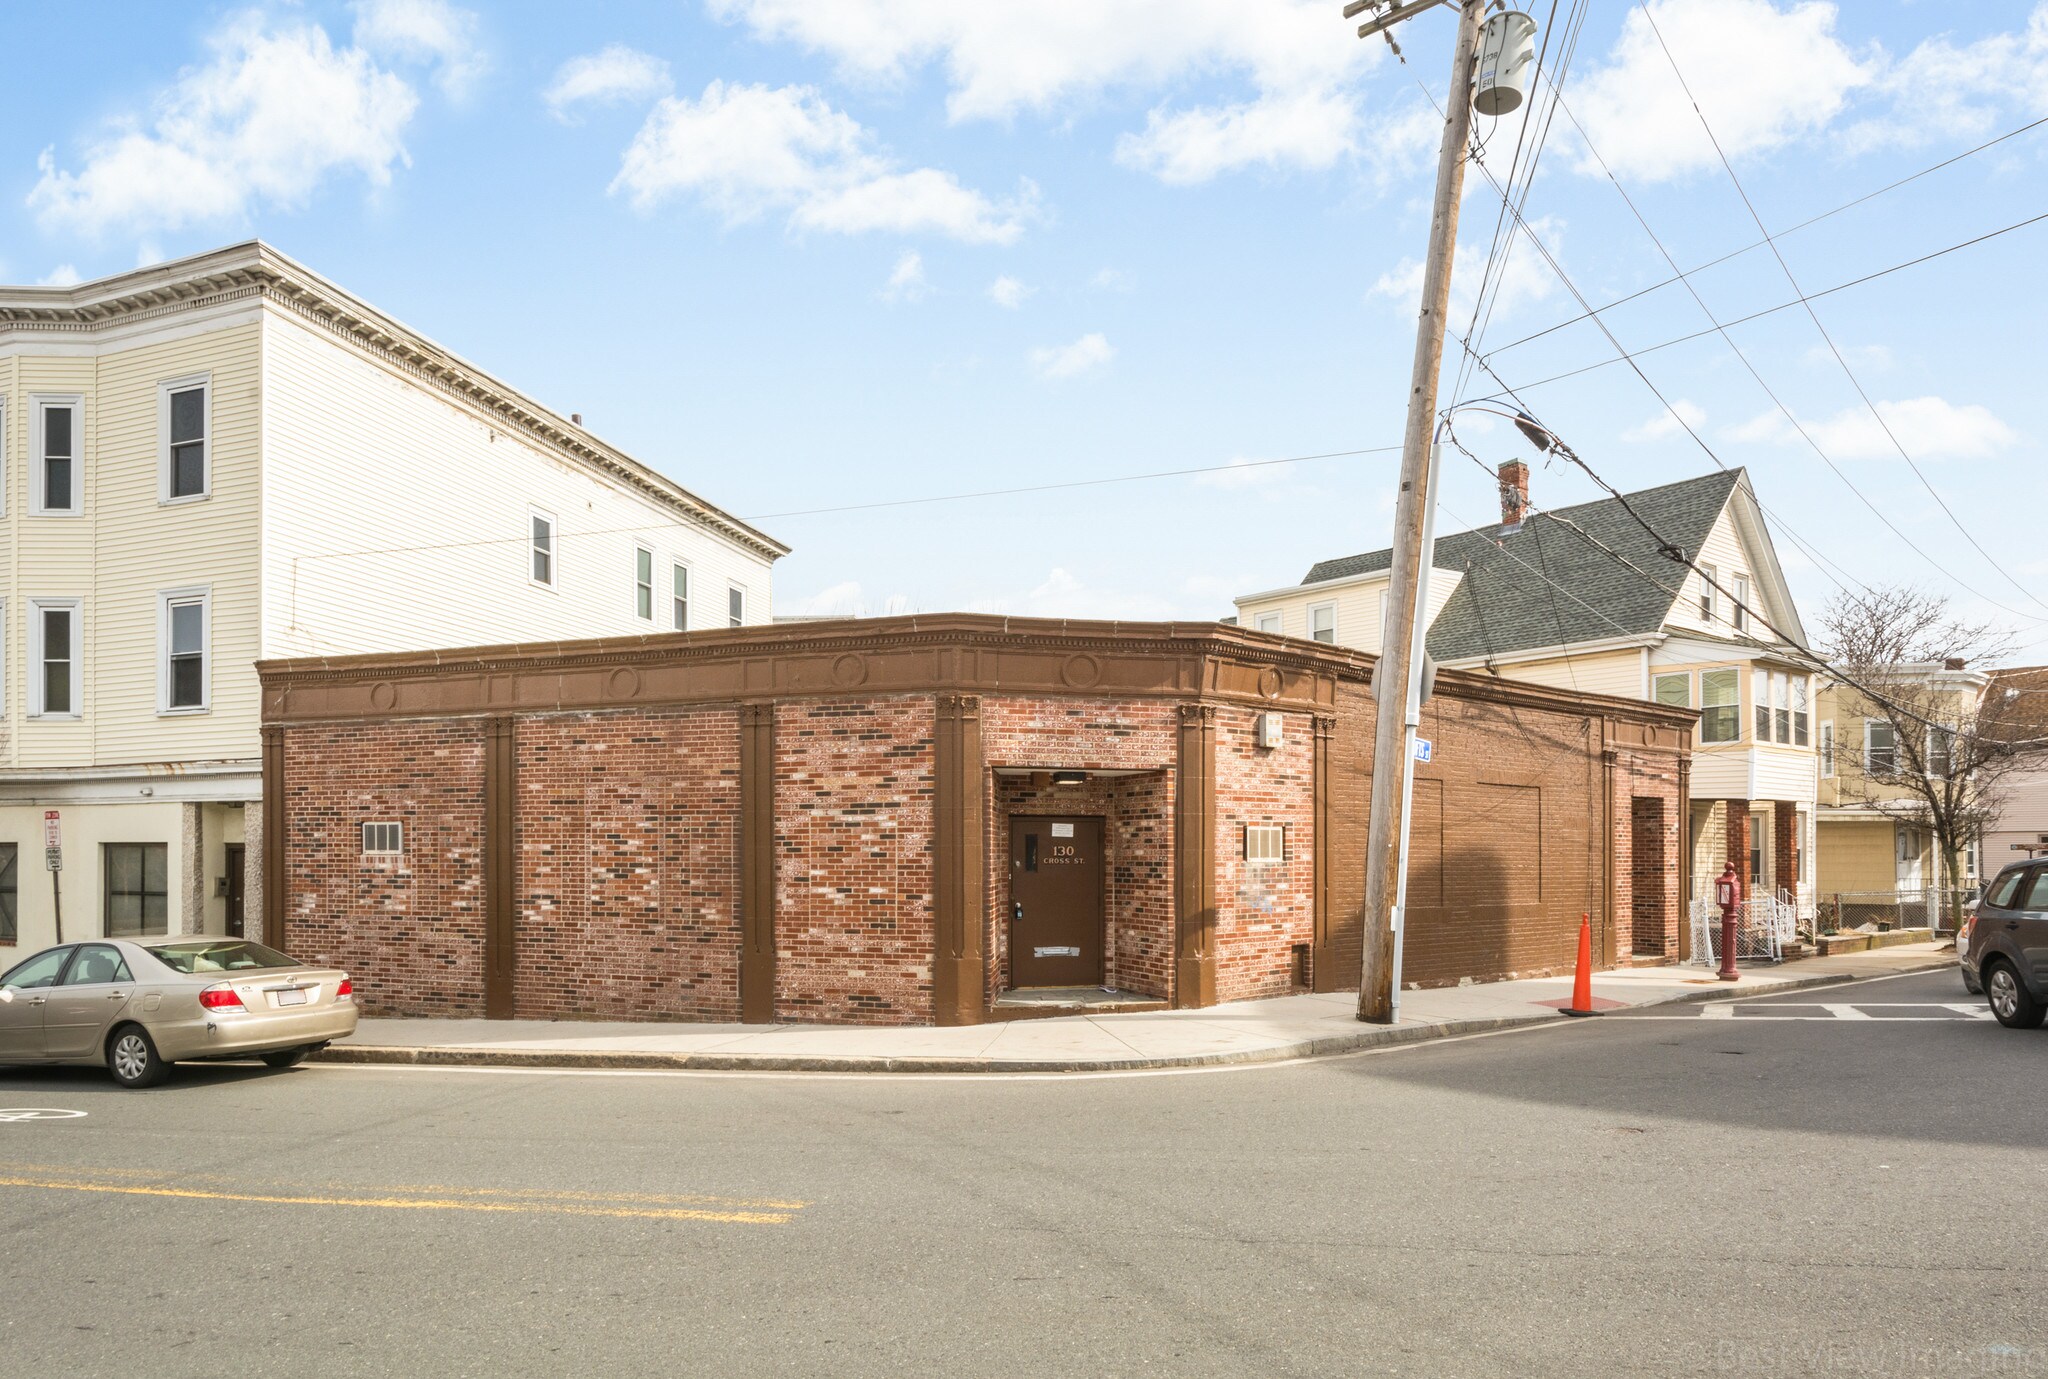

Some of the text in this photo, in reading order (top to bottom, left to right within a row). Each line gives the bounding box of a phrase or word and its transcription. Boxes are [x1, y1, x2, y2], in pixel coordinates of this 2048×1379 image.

[1053, 845, 1075, 856] 130
[1043, 857, 1086, 865] CROSS ST.
